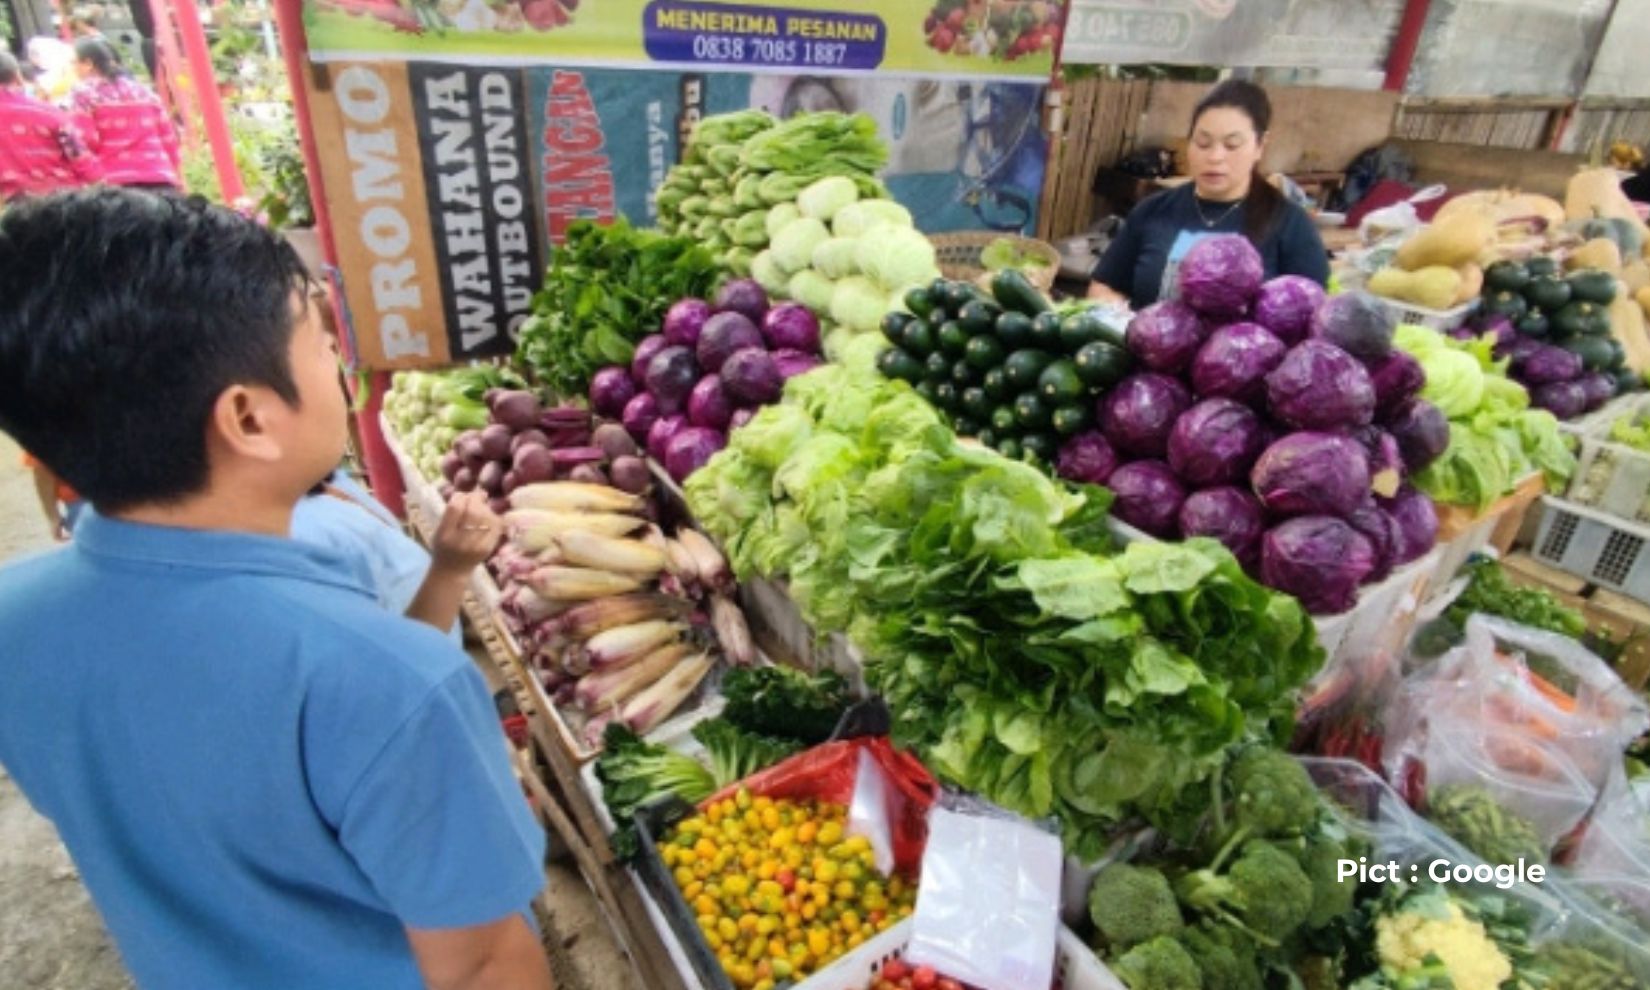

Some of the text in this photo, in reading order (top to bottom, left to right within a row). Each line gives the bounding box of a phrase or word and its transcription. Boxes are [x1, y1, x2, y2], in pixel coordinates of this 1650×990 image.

[656, 8, 878, 41] MENERIMA PESANAN
[693, 35, 847, 64] 0838 7085 1887
[335, 66, 429, 361] PROMO
[425, 71, 498, 352] WAHANA
